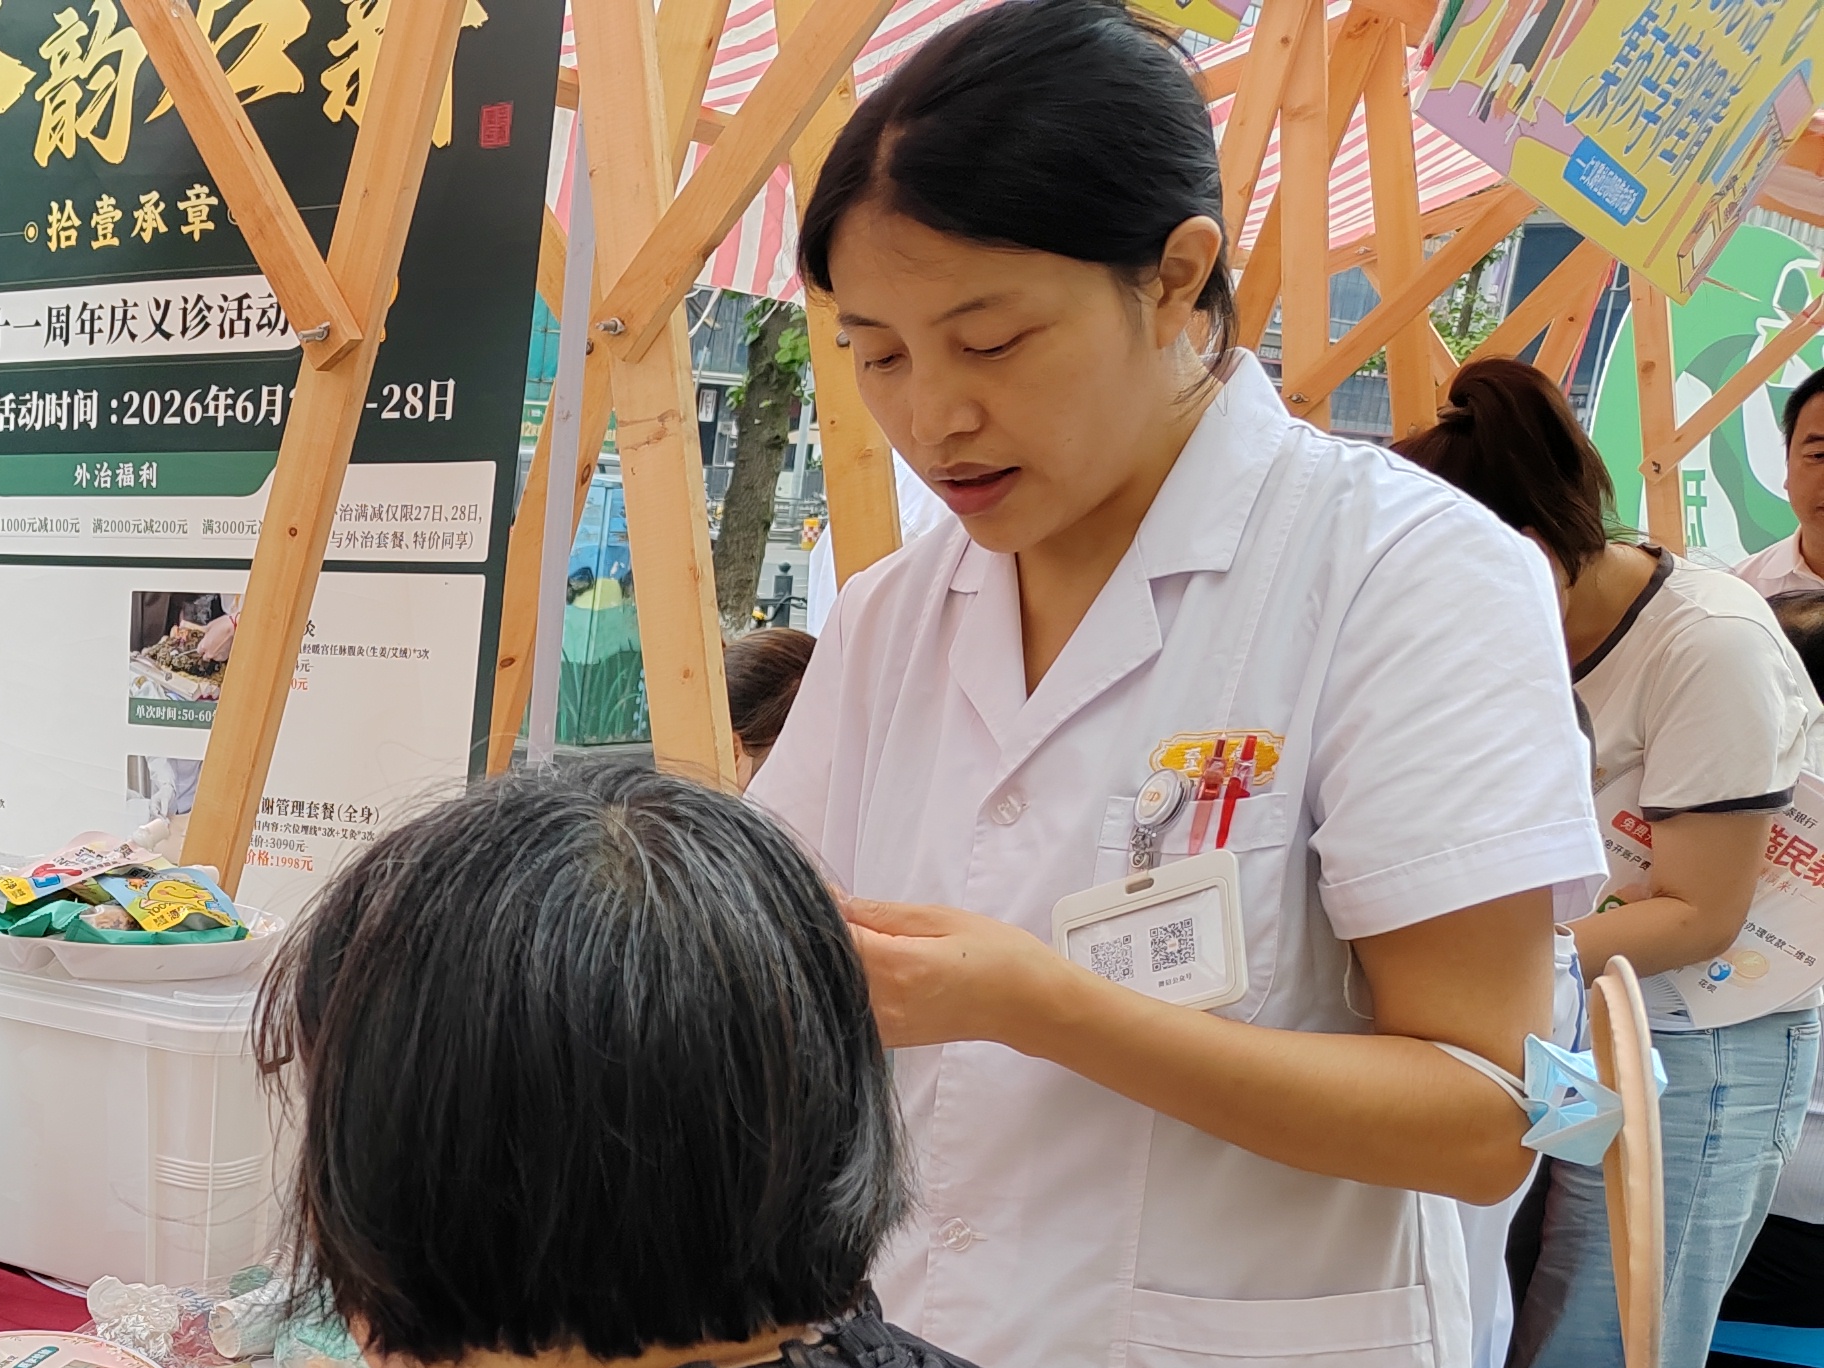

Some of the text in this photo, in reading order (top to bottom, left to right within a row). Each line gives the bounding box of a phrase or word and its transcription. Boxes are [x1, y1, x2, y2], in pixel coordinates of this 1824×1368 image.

[46, 184, 219, 253] 拾壹承章
[74, 462, 158, 489] 外治福利
[92, 517, 188, 536] 满2000元减200元
[334, 503, 484, 525] 治满减仅限27日、28日，
[257, 797, 380, 825] 谢管理套餐（全身）
[1743, 918, 1818, 968] 办理收款二维码
